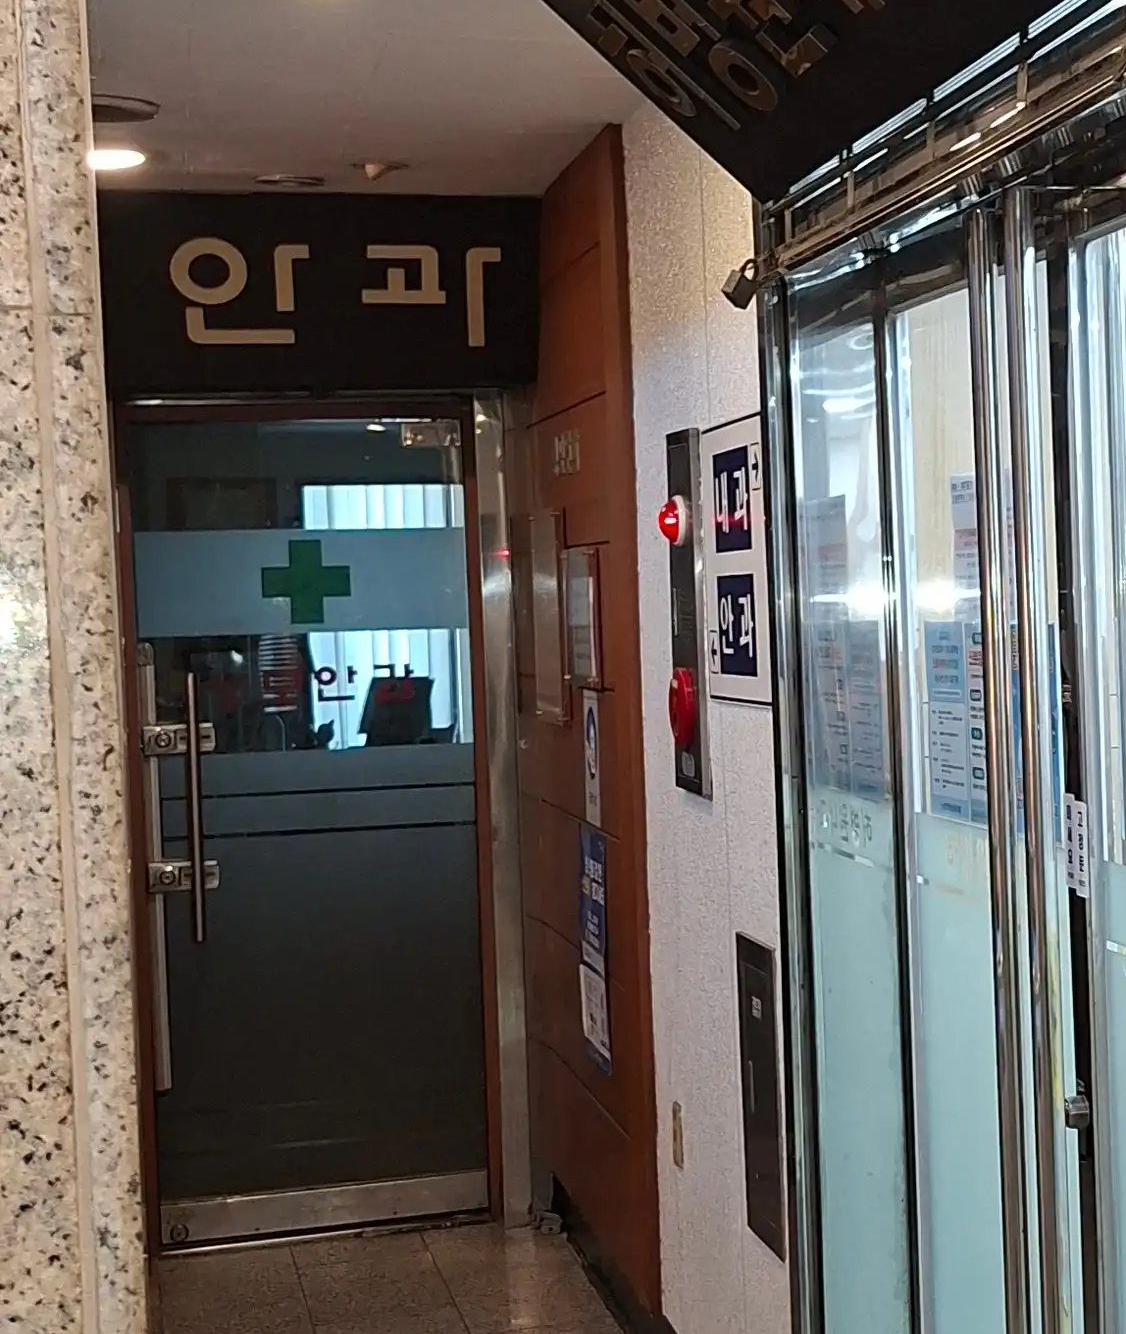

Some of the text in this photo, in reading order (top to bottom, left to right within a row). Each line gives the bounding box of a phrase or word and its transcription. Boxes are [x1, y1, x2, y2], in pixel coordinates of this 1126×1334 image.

[169, 237, 502, 347] 안과
[714, 467, 749, 534] 내과
[719, 593, 754, 658] 안과
